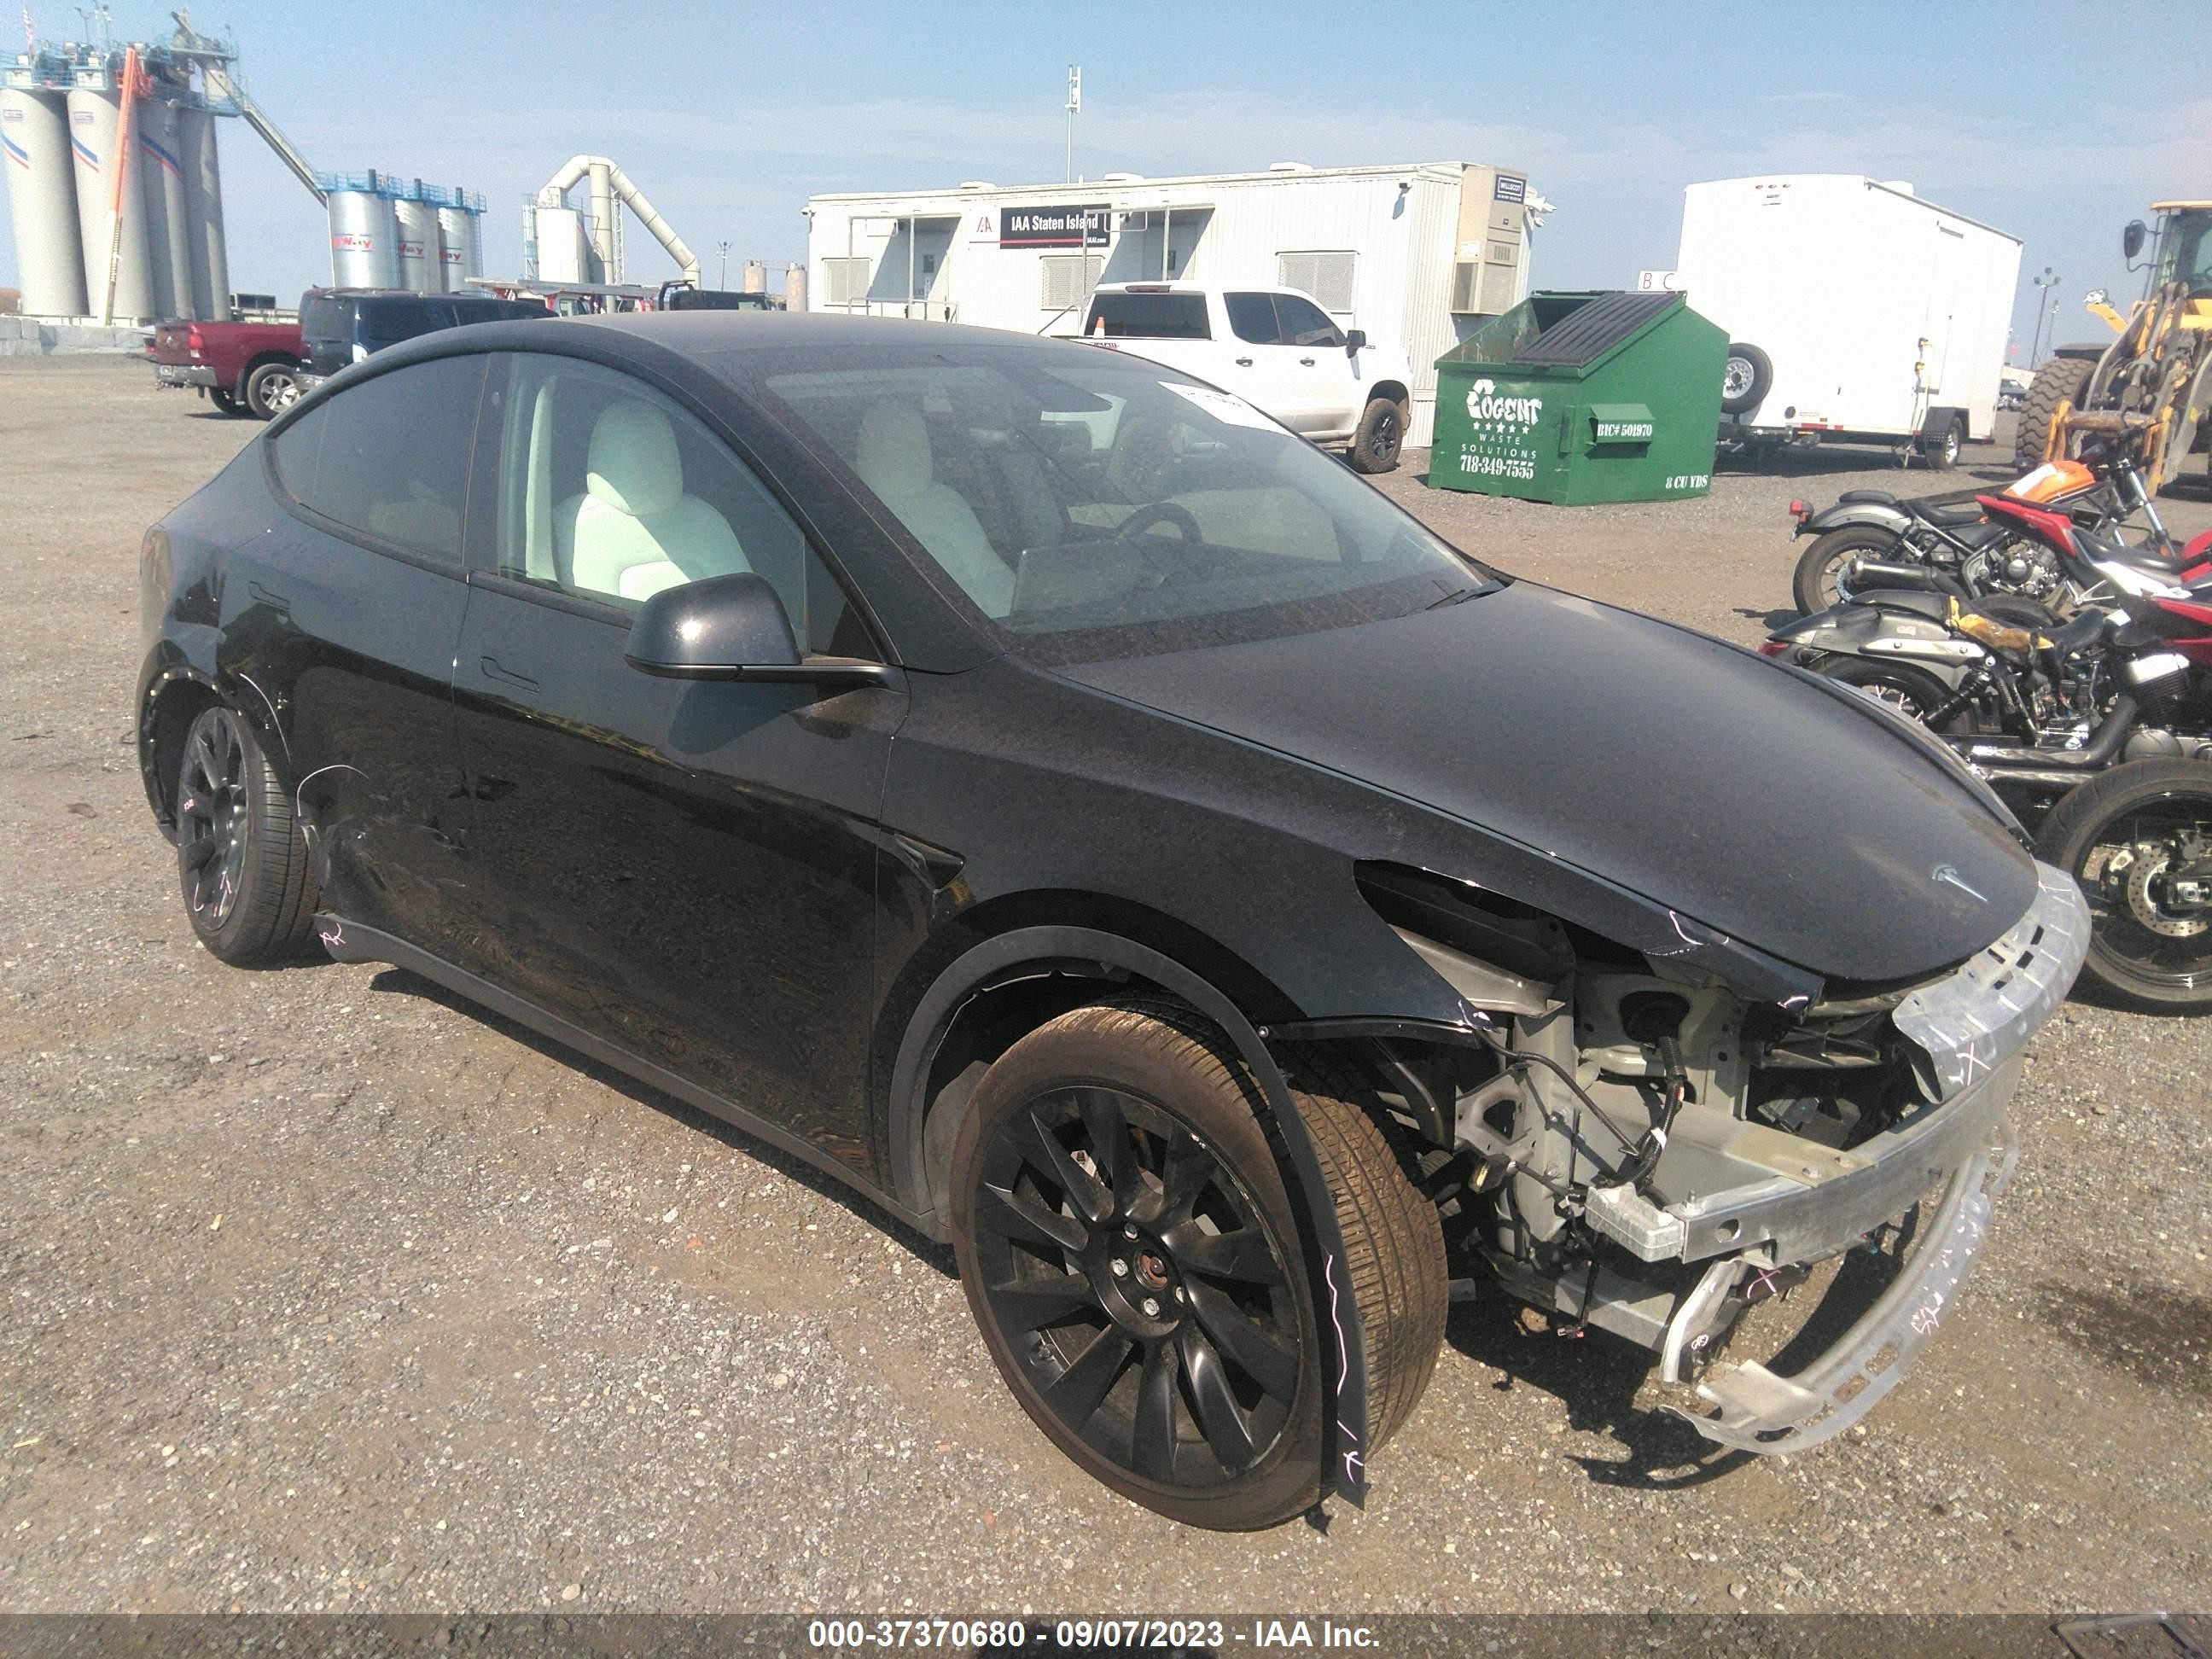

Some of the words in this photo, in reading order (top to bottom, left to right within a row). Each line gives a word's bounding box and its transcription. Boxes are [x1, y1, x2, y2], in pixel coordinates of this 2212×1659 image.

[1011, 215, 1030, 231] IAA
[1032, 215, 1063, 230] Staten
[1067, 213, 1098, 230] Island
[1643, 272, 1652, 289] B
[1663, 272, 1676, 290] C
[1597, 424, 1621, 437] BIC#
[1621, 424, 1653, 437] 501970
[1479, 433, 1521, 445] WASTE
[1461, 444, 1537, 459] SOLUTIONS
[1460, 455, 1534, 479] 718-349-7555
[1665, 477, 1673, 489] 8
[1674, 475, 1689, 488] CU
[1690, 474, 1708, 488] YDS
